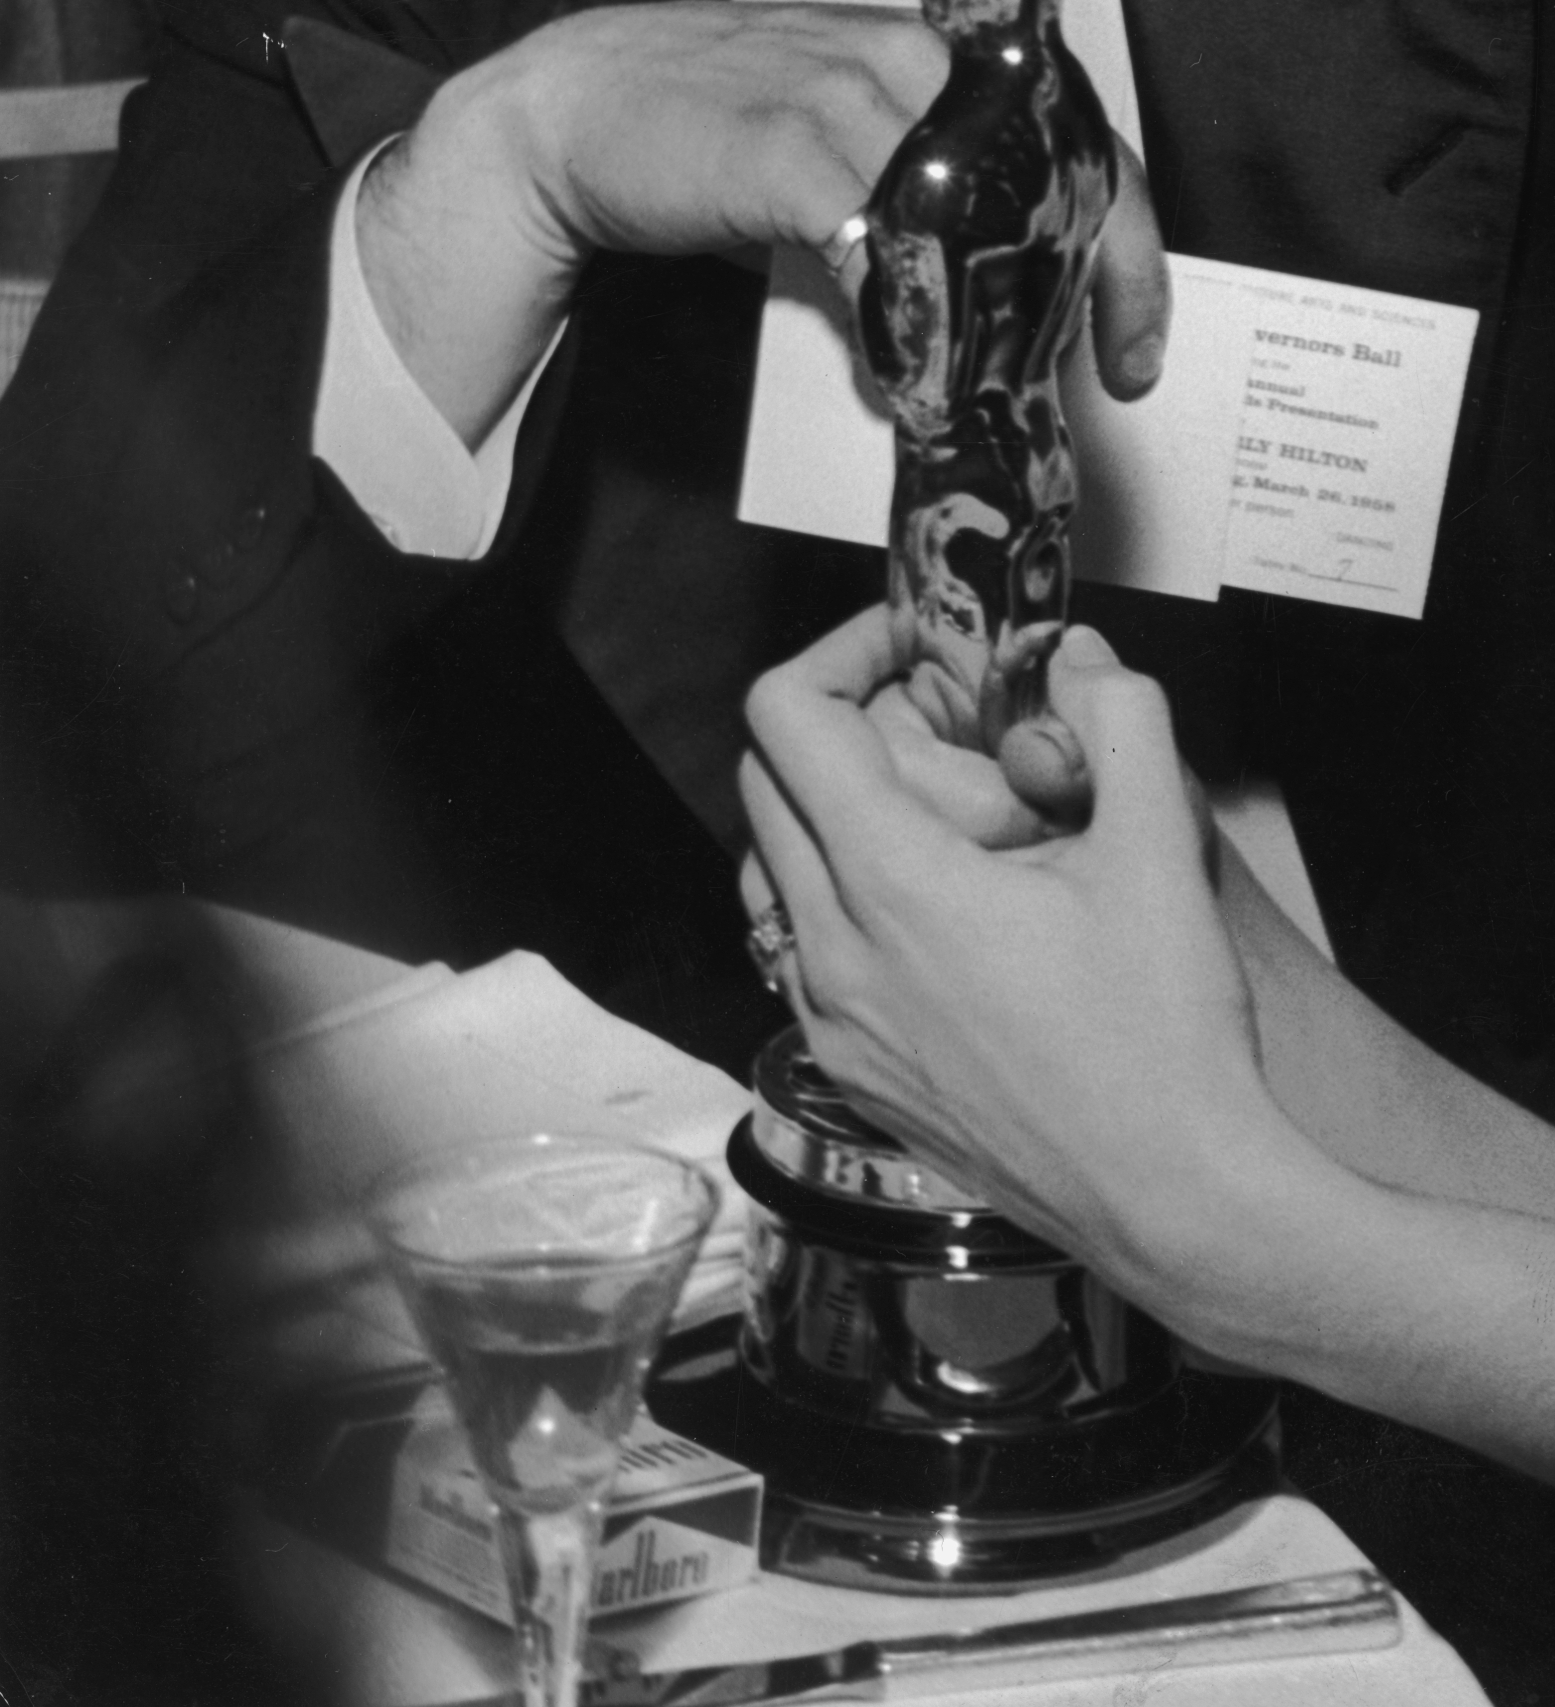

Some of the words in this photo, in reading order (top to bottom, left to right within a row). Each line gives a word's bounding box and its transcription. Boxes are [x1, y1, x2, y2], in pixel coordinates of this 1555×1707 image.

[1351, 342, 1402, 368] Ball
[1266, 397, 1380, 430] Presentation
[1278, 442, 1369, 474] HILTON
[1253, 476, 1310, 498] March
